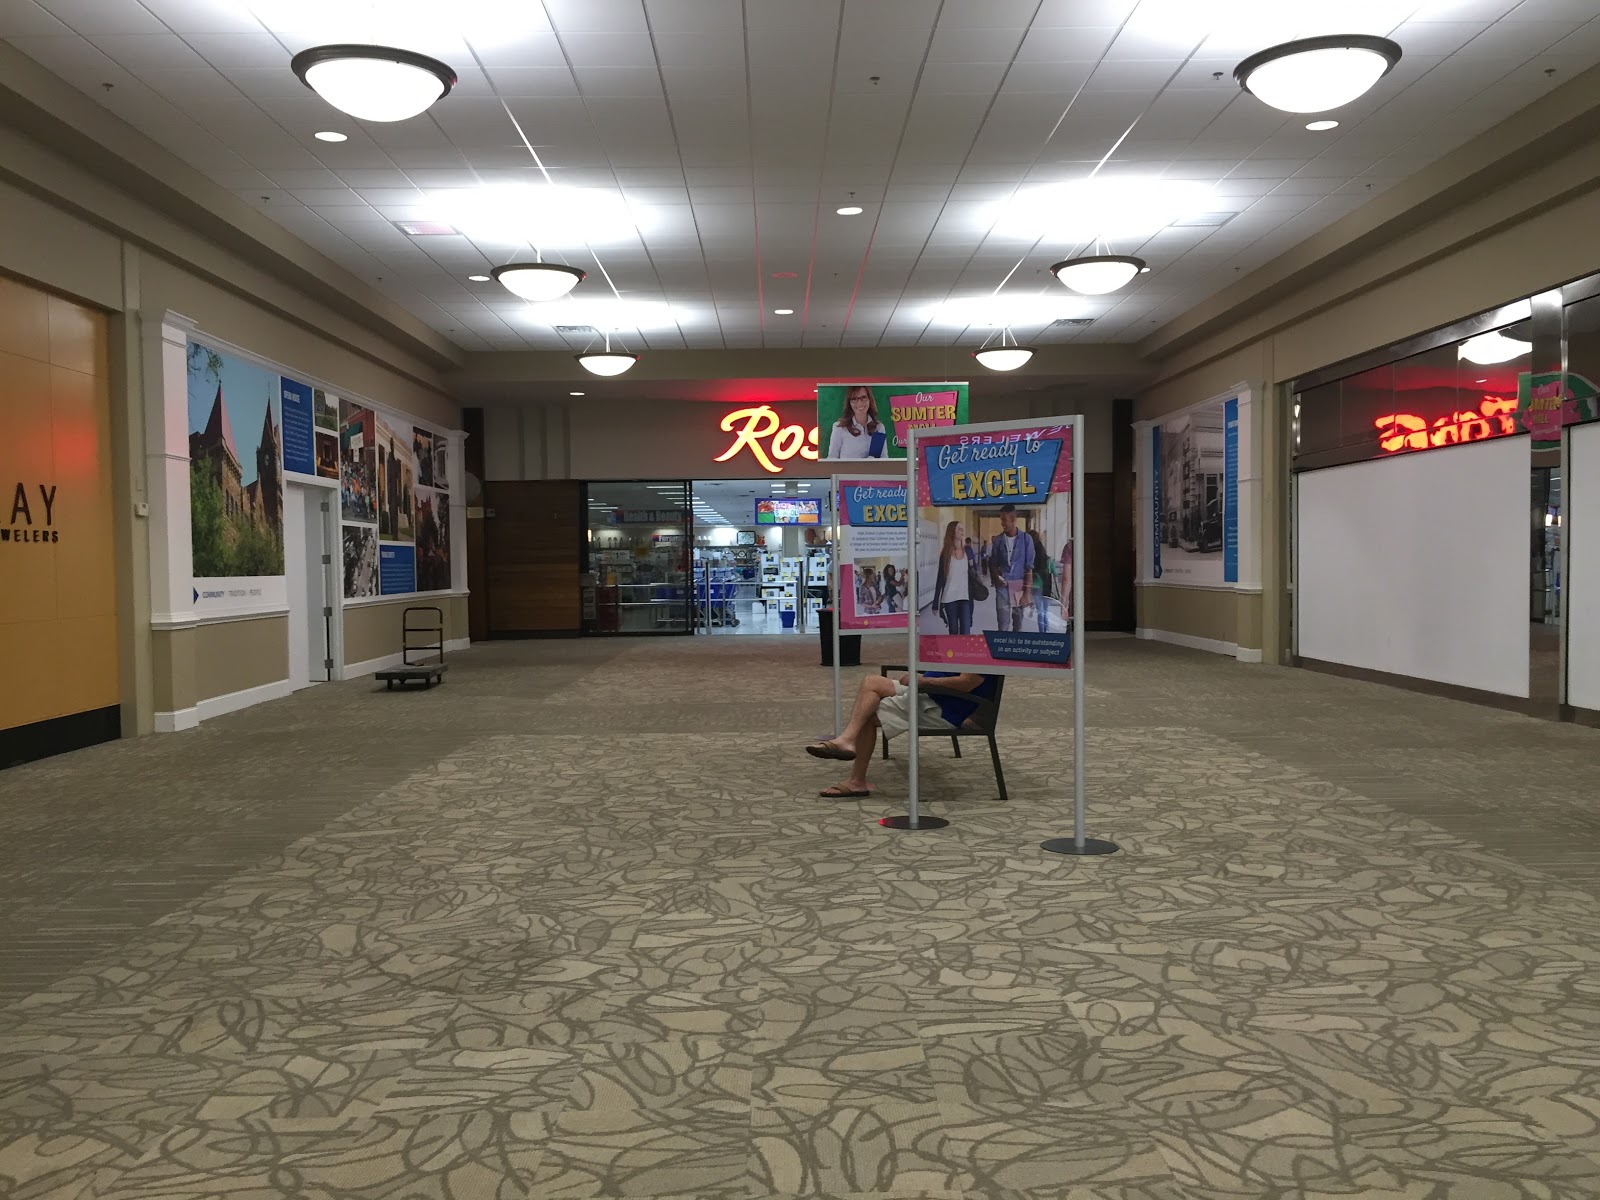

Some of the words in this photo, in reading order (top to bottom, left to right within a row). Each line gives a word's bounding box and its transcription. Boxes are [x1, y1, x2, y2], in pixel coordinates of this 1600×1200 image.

[915, 391, 935, 404] Our
[891, 404, 957, 422] SUMTER
[713, 404, 818, 473] Ros
[938, 444, 969, 470] Get
[971, 438, 1019, 466] ready
[1025, 438, 1045, 454] to
[951, 466, 1037, 500] EXCEL
[853, 485, 874, 502] Get
[875, 484, 907, 504] ready
[10, 482, 57, 526] AY
[863, 503, 908, 522] EXCE
[0, 529, 59, 543] WELERS
[1012, 647, 1032, 655] activity
[1039, 648, 1060, 656] subject
[1031, 639, 1065, 648] outstanding
